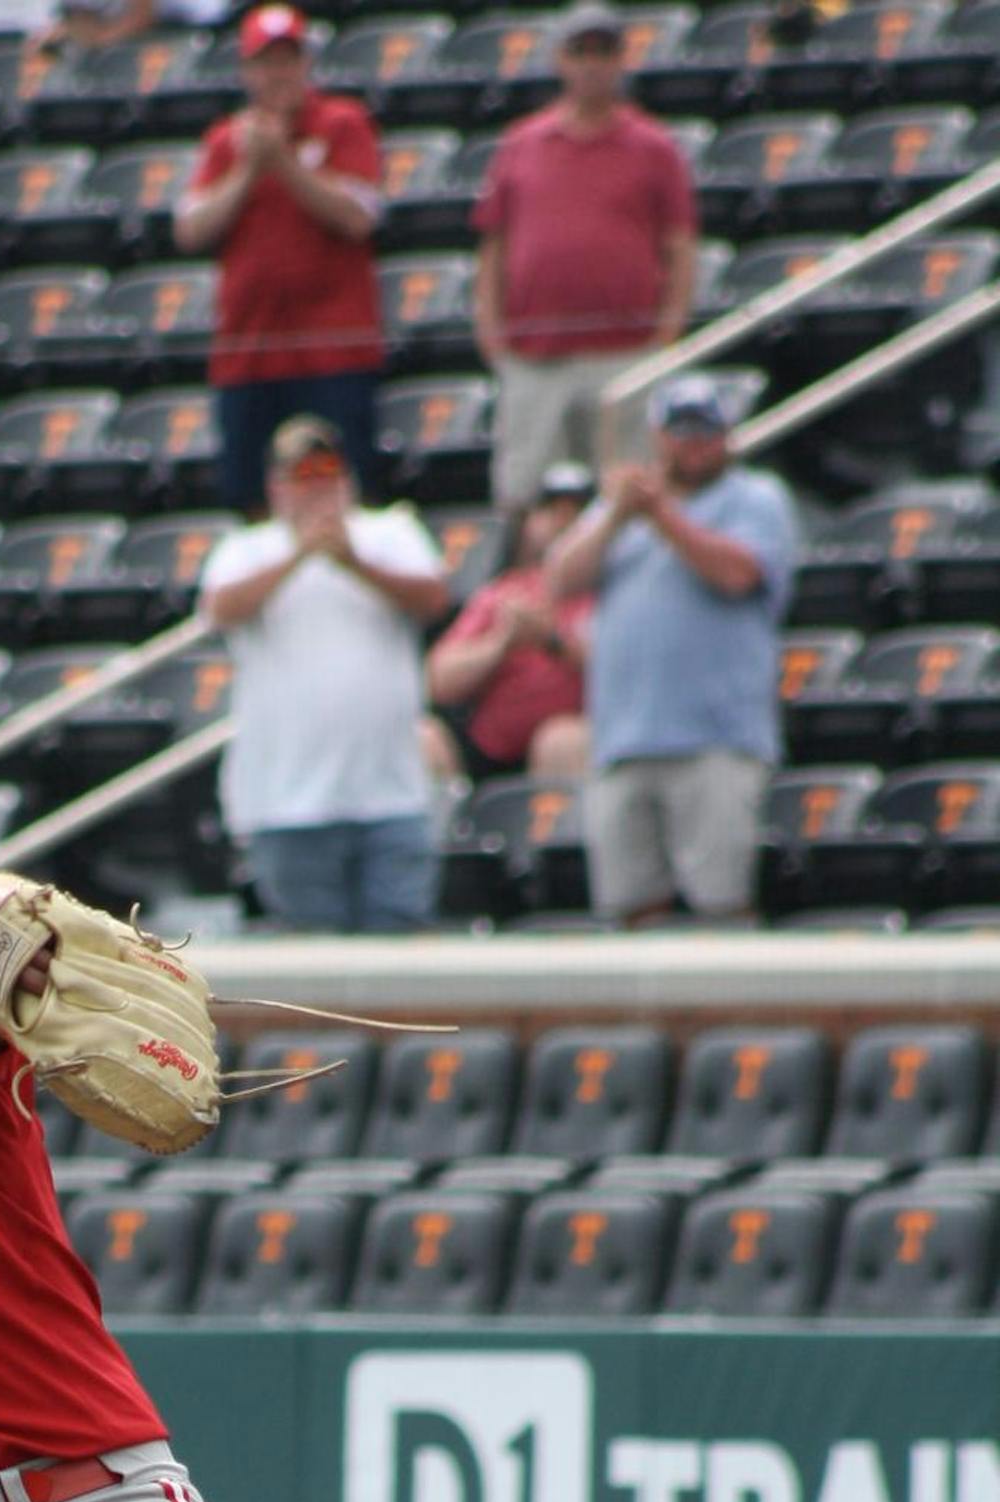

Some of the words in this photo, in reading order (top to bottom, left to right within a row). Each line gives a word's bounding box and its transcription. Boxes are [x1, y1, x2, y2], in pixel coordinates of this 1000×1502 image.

[426, 1049, 461, 1101] T
[576, 1049, 611, 1102] T
[734, 1046, 769, 1098] T
[891, 1046, 927, 1098] T
[110, 1210, 145, 1258] T
[258, 1211, 295, 1262] T
[415, 1213, 450, 1265] T
[570, 1213, 606, 1264] T
[731, 1210, 768, 1263] T
[897, 1210, 934, 1262] T
